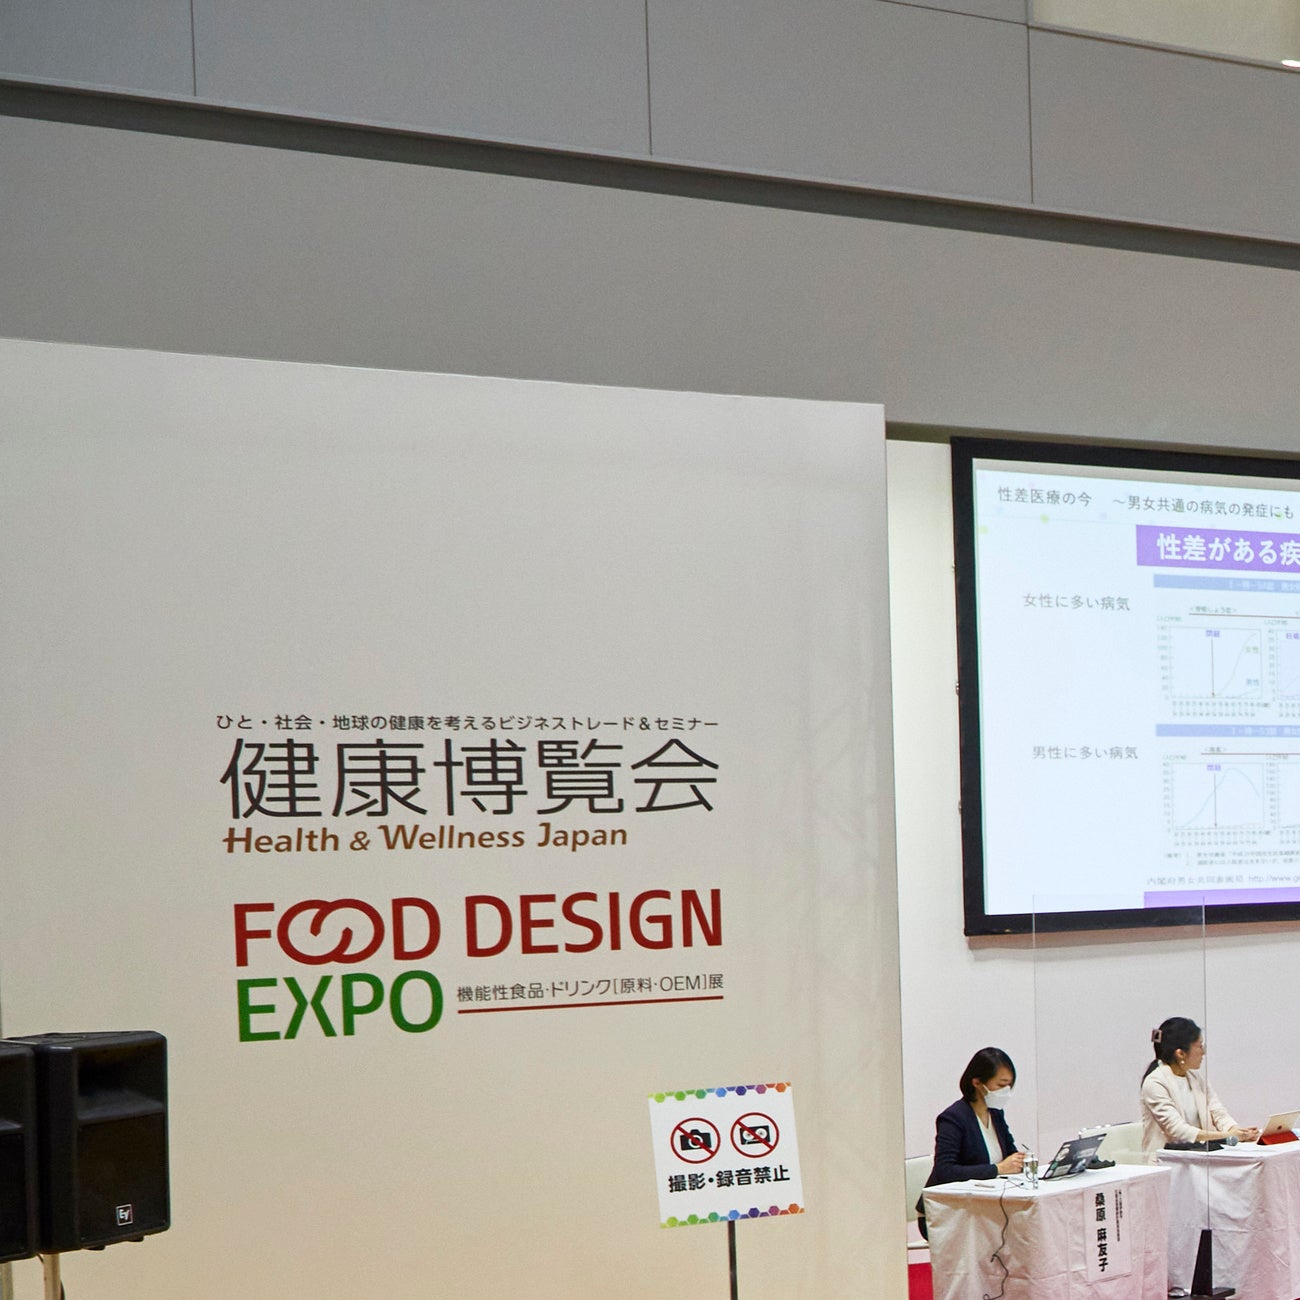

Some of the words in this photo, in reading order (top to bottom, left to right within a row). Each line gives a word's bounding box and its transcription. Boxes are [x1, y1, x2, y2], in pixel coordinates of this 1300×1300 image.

[998, 486, 1092, 506] 性差医療の今
[1023, 593, 1130, 611] 女性に多い病気
[1032, 745, 1138, 760] 男性に多い病気
[220, 738, 719, 819] 健康博覧会
[222, 827, 339, 853] Health
[349, 831, 371, 851] &
[377, 824, 525, 850] Wellness
[537, 822, 628, 852] Japan
[234, 897, 441, 967] FOOD
[465, 888, 722, 957] DESIGN
[237, 970, 443, 1042] EXPO
[668, 1165, 790, 1193] 撮影・録音禁止
[1097, 1228, 1108, 1272] 麻友子
